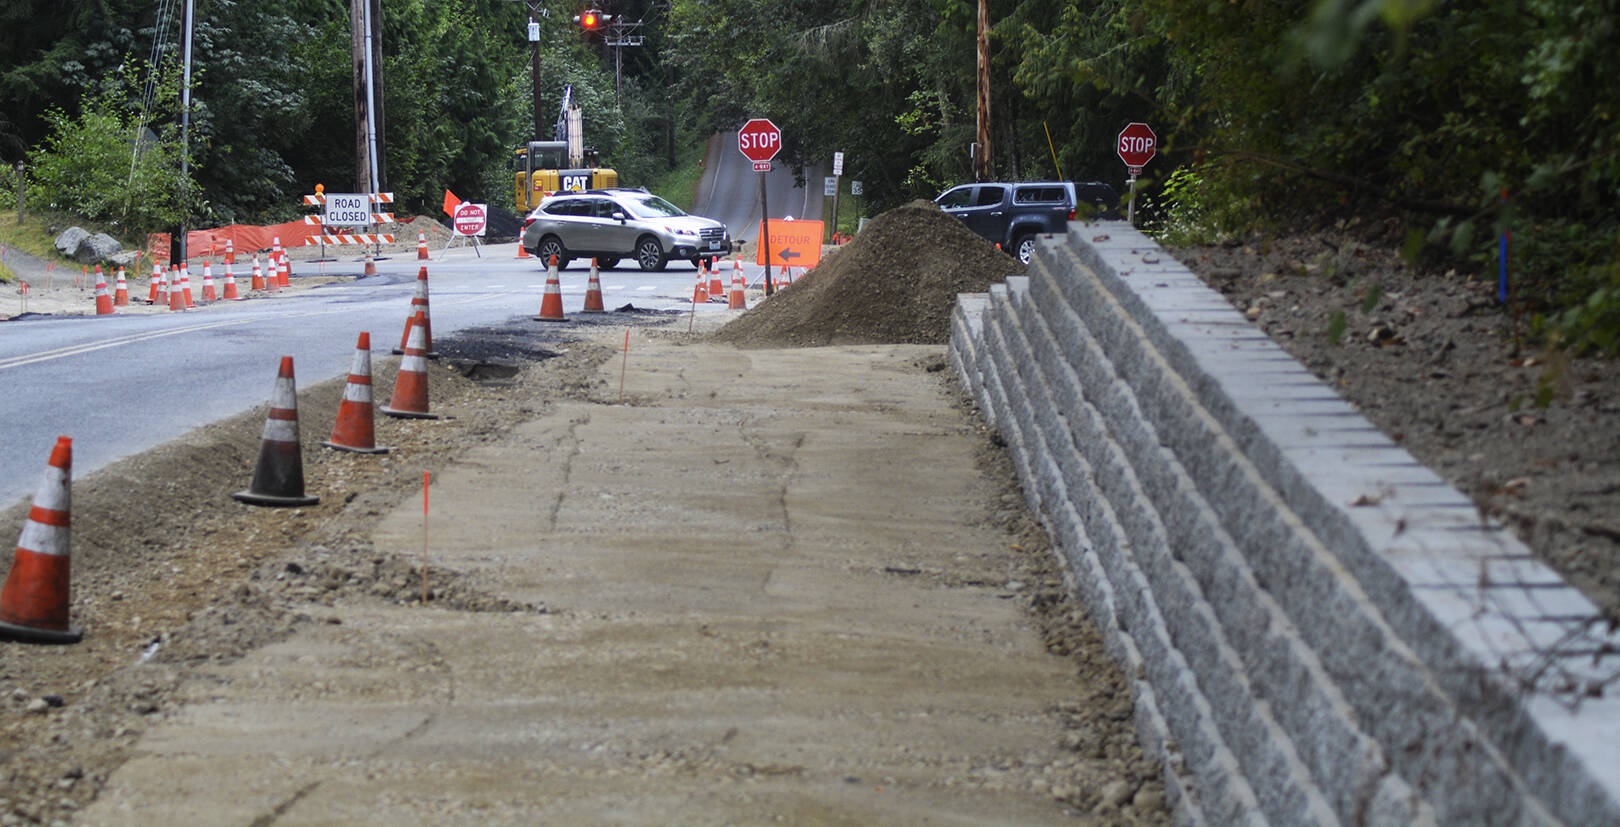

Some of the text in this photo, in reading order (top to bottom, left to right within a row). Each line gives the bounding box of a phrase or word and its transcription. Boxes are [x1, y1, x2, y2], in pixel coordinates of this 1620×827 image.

[741, 132, 778, 148] STOP
[1120, 136, 1153, 153] STOP
[563, 176, 588, 192] CAT
[335, 198, 360, 208] ROAD
[329, 211, 366, 221] CLOSED
[770, 235, 810, 244] DETOUR
